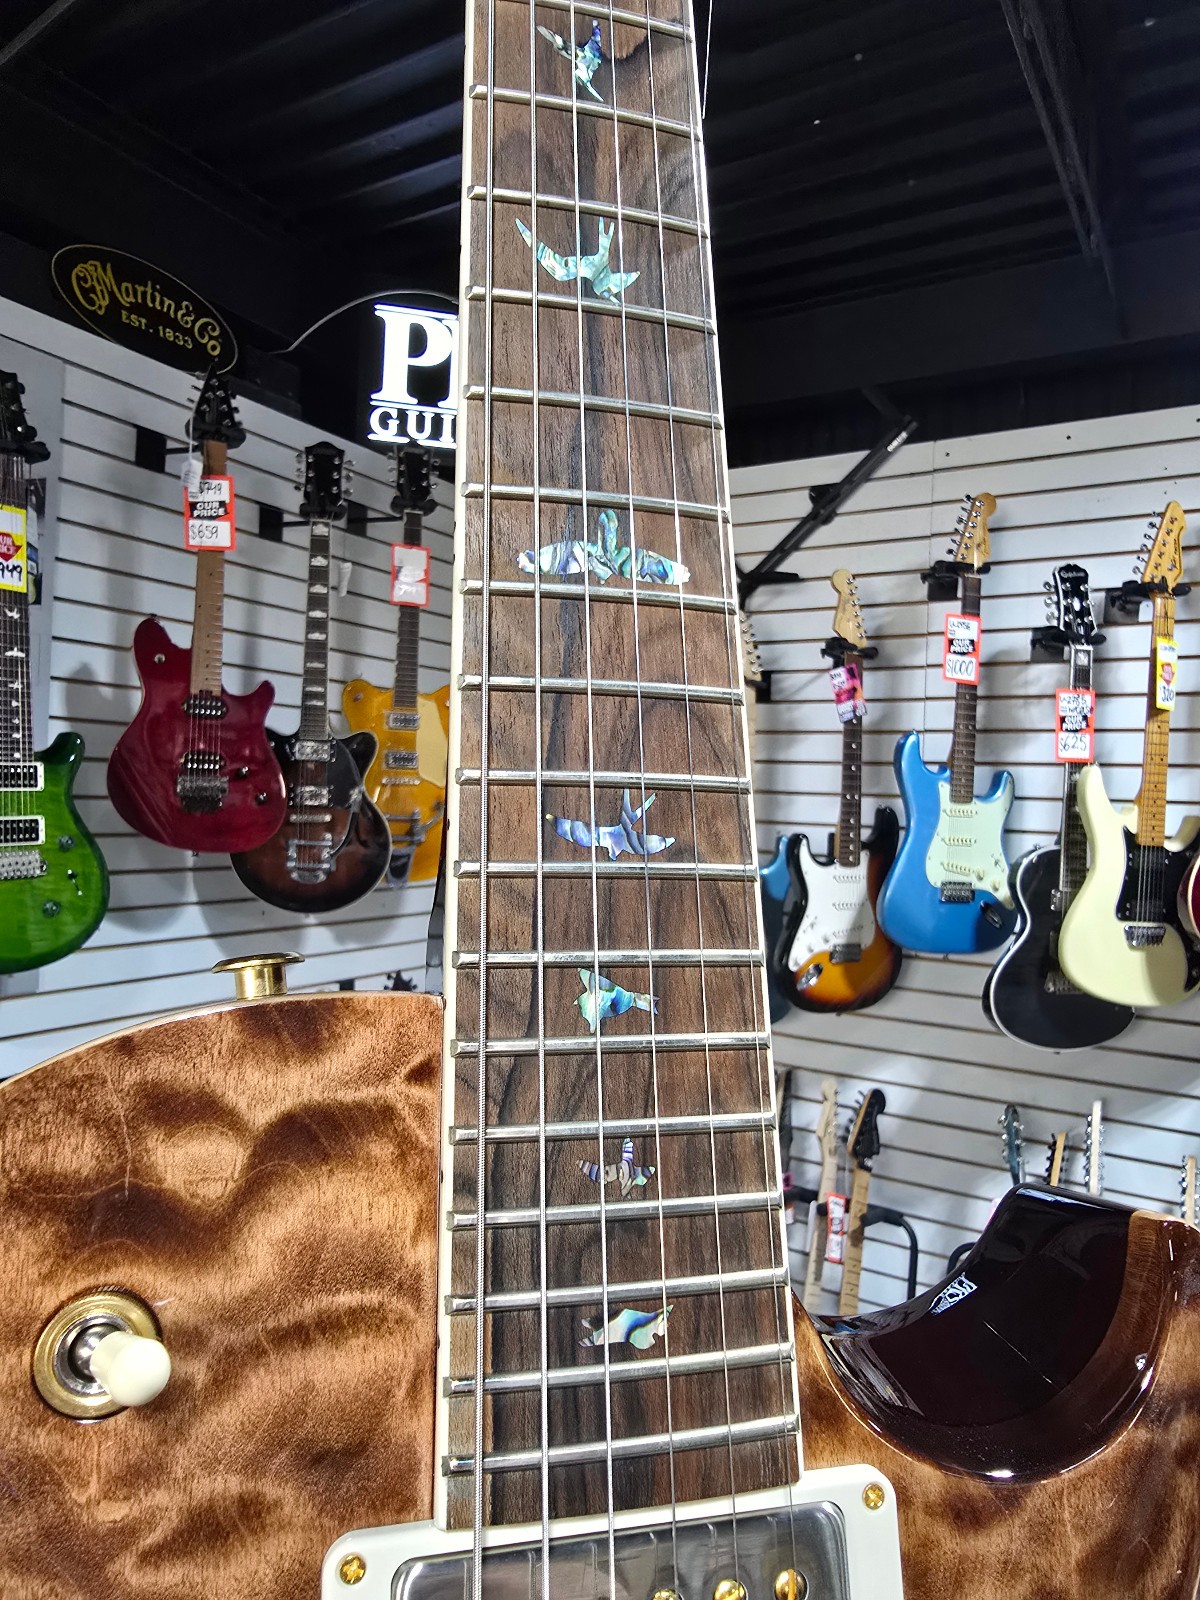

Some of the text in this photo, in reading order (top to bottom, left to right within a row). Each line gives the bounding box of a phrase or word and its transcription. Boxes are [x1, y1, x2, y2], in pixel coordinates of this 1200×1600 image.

[158, 325, 194, 350] 1833
[193, 508, 225, 518] PRICE
[196, 502, 220, 511] OUR
[190, 523, 219, 541] $659
[946, 658, 974, 677] $1000
[1058, 732, 1087, 752] $625
